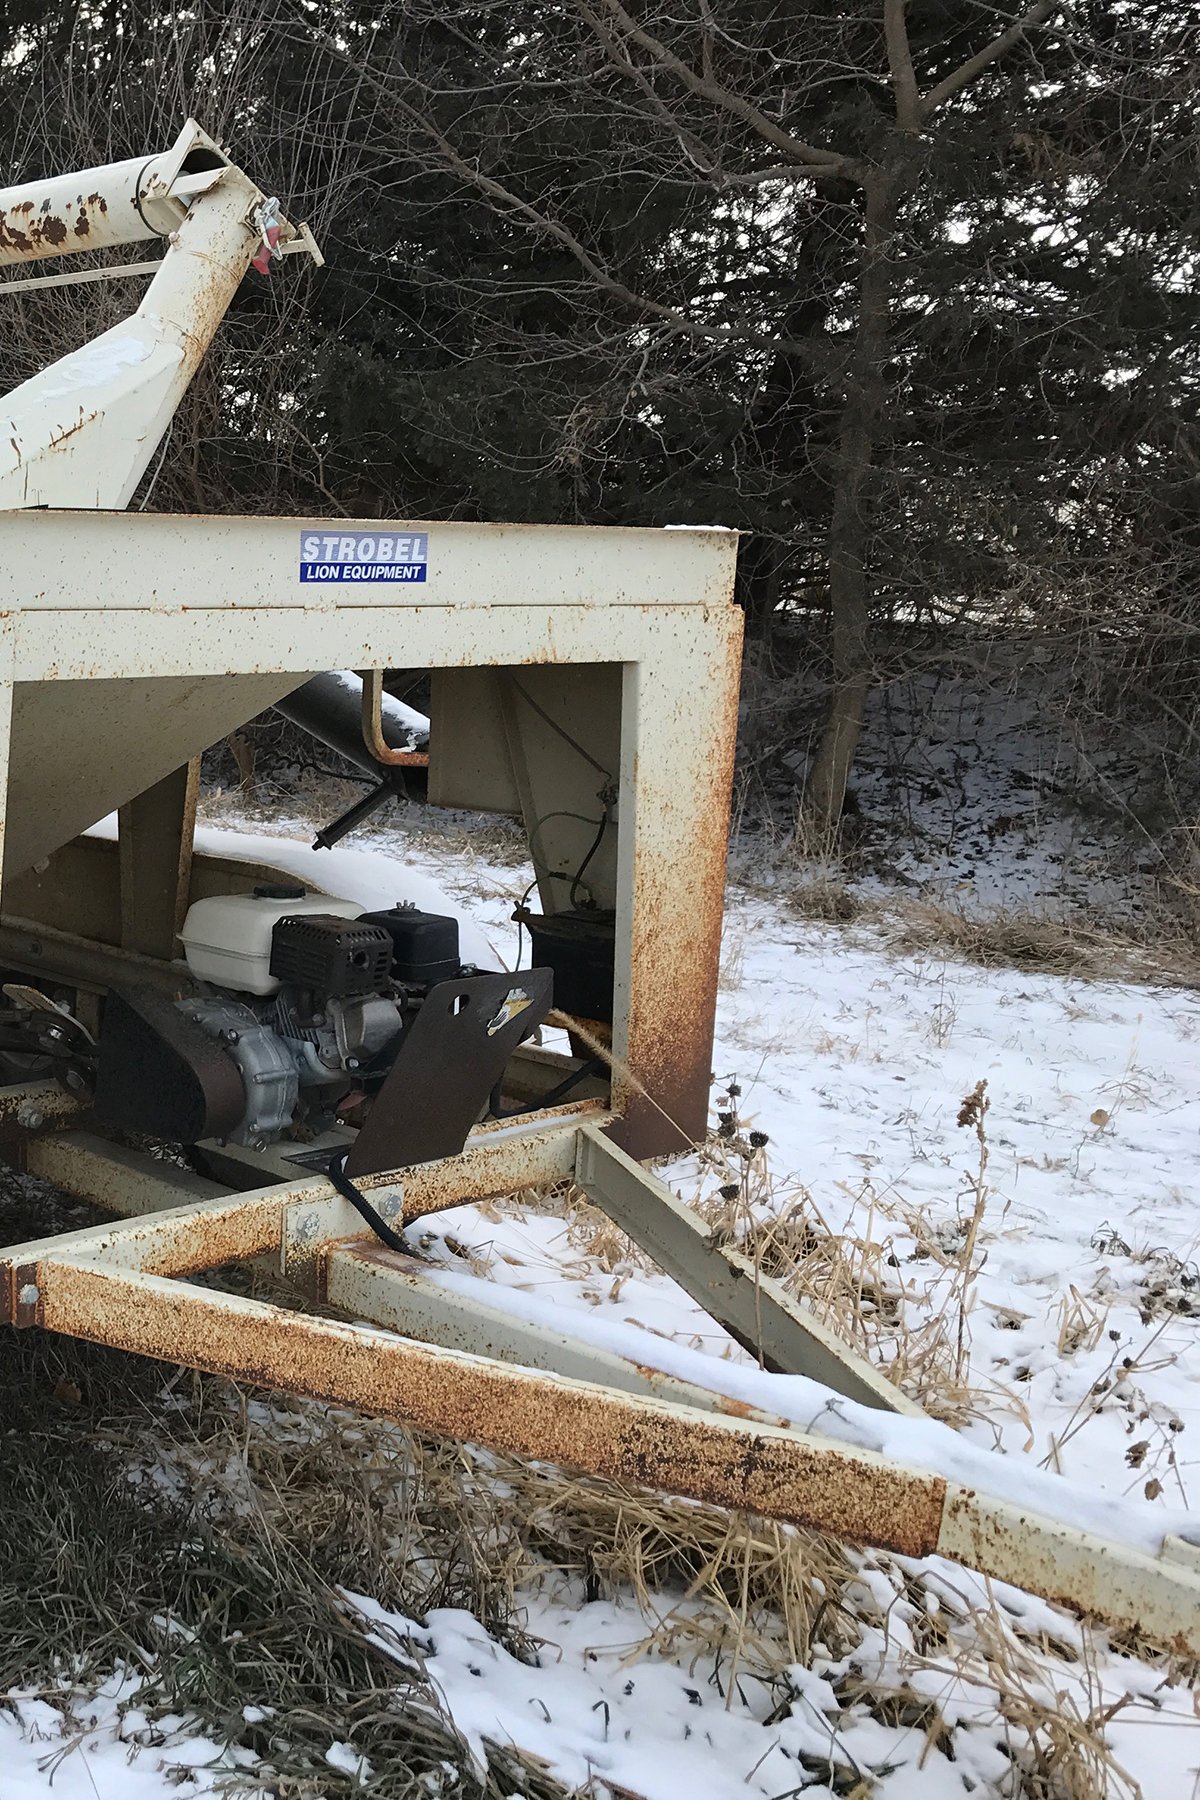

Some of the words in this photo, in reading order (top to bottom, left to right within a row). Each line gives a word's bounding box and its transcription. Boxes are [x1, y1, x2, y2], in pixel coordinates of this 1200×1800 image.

[302, 536, 425, 562] STROBEL
[306, 565, 340, 580] LION
[343, 565, 421, 580] EQUIPMENT
